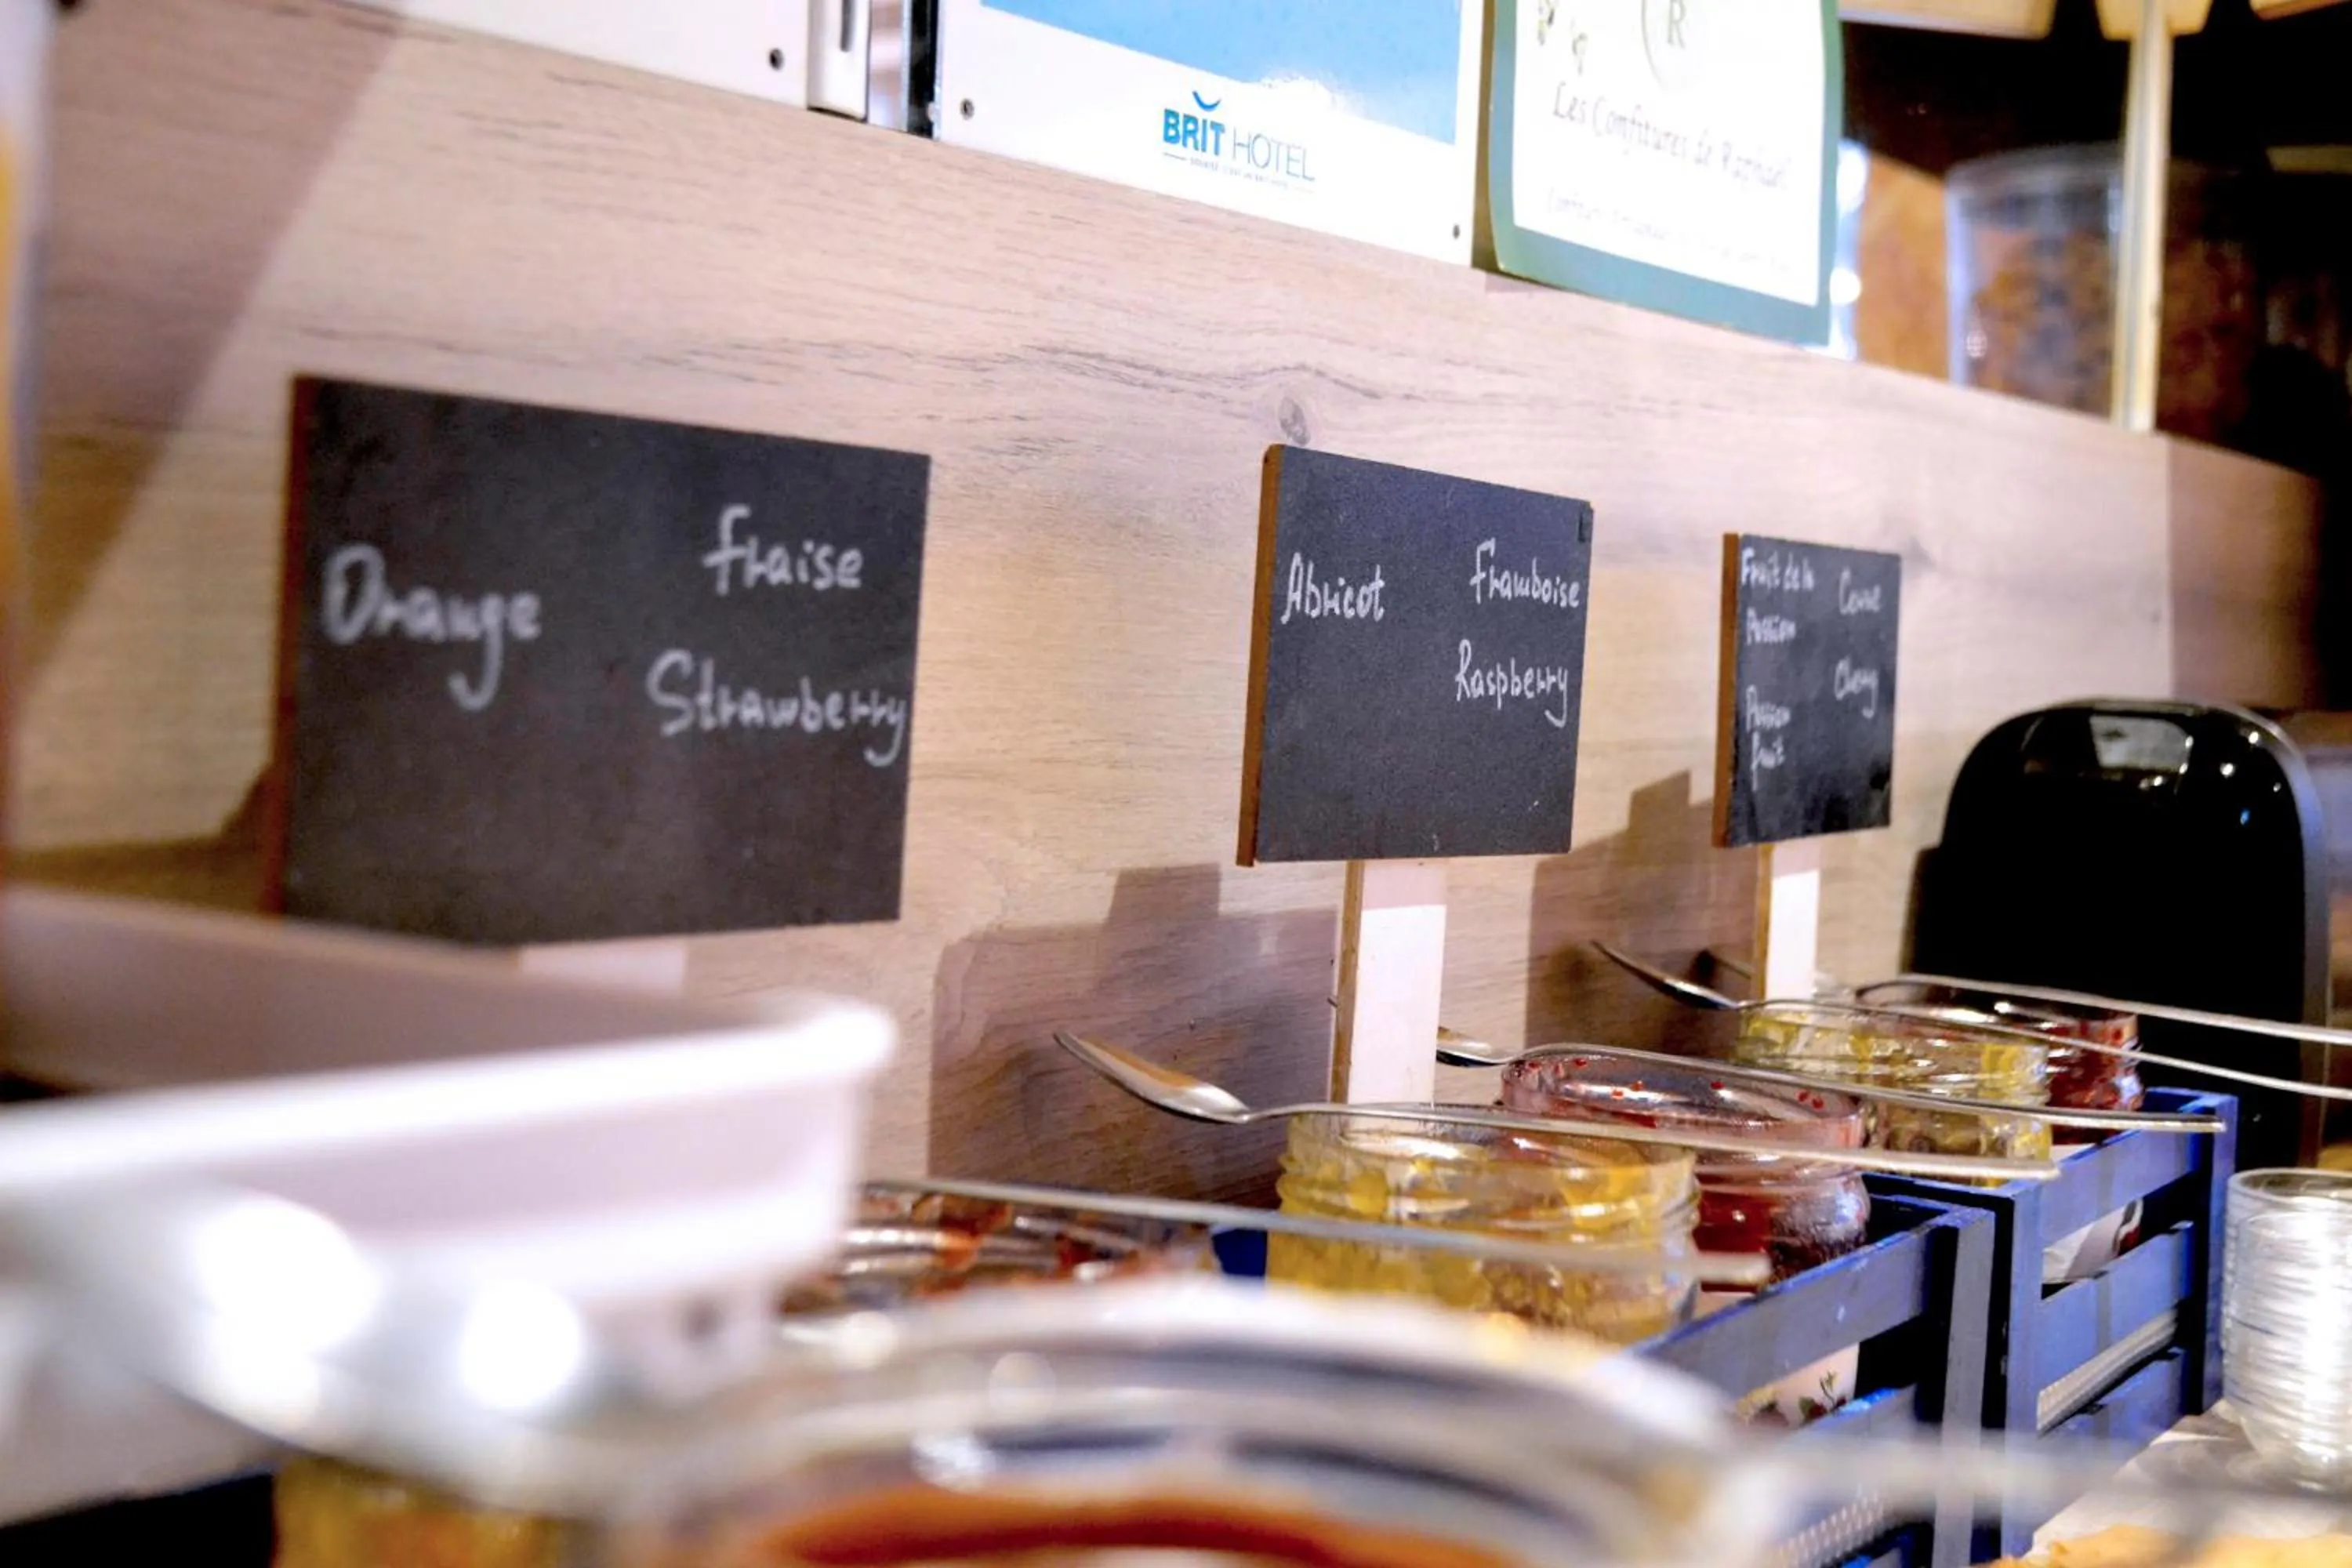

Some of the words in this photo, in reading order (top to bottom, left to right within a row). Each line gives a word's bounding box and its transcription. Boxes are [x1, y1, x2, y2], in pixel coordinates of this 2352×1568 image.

[1551, 80, 1587, 125] Les
[1163, 107, 1226, 157] BRIT
[1232, 126, 1316, 182] HOTEL
[1279, 551, 1386, 625] Abricot
[1470, 537, 1581, 609] Framboise
[322, 543, 543, 712] Orange
[644, 648, 908, 768] Strawberry
[1454, 638, 1570, 728] Raspberry
